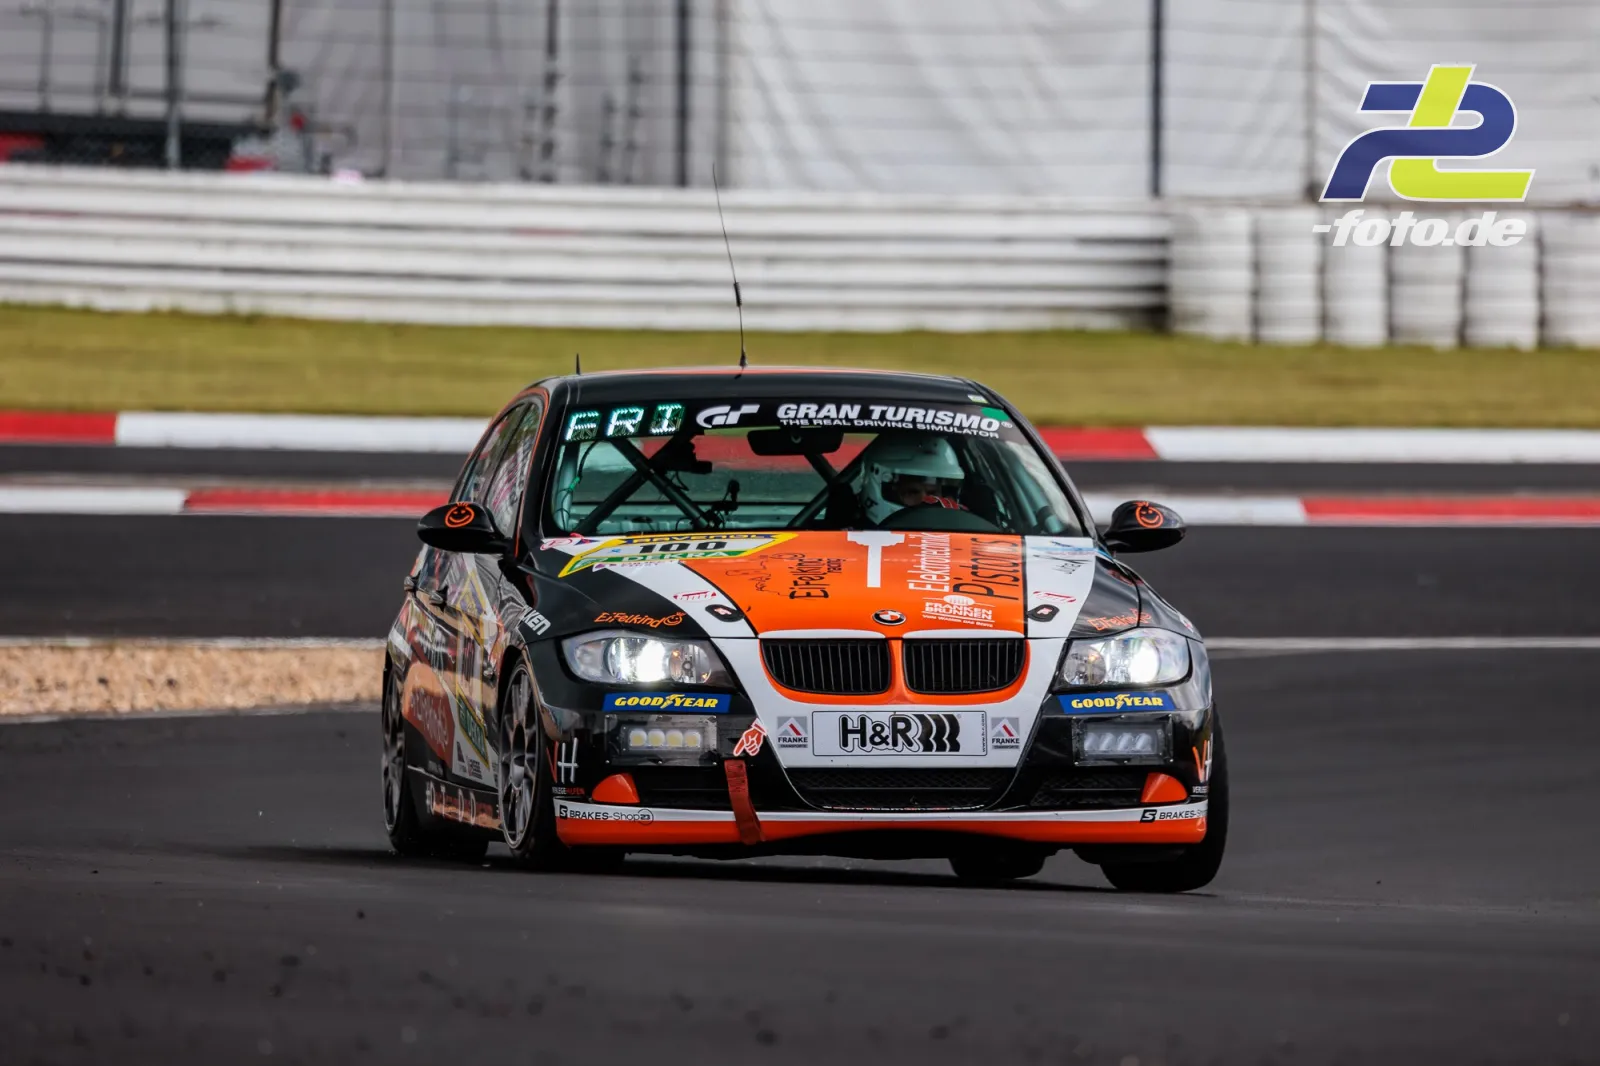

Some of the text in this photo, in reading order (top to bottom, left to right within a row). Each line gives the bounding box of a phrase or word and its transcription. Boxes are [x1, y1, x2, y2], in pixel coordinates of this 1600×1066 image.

[777, 403, 861, 419] GRAN
[853, 419, 913, 429] DRIVING
[917, 422, 999, 438] SIMULATOR
[640, 541, 728, 554] 100
[621, 552, 730, 562] DEKRA
[925, 602, 992, 615] FRANKEN
[614, 693, 719, 709] GOODYEAR
[1071, 694, 1164, 709] GOODYEAR
[839, 714, 920, 752] H&R
